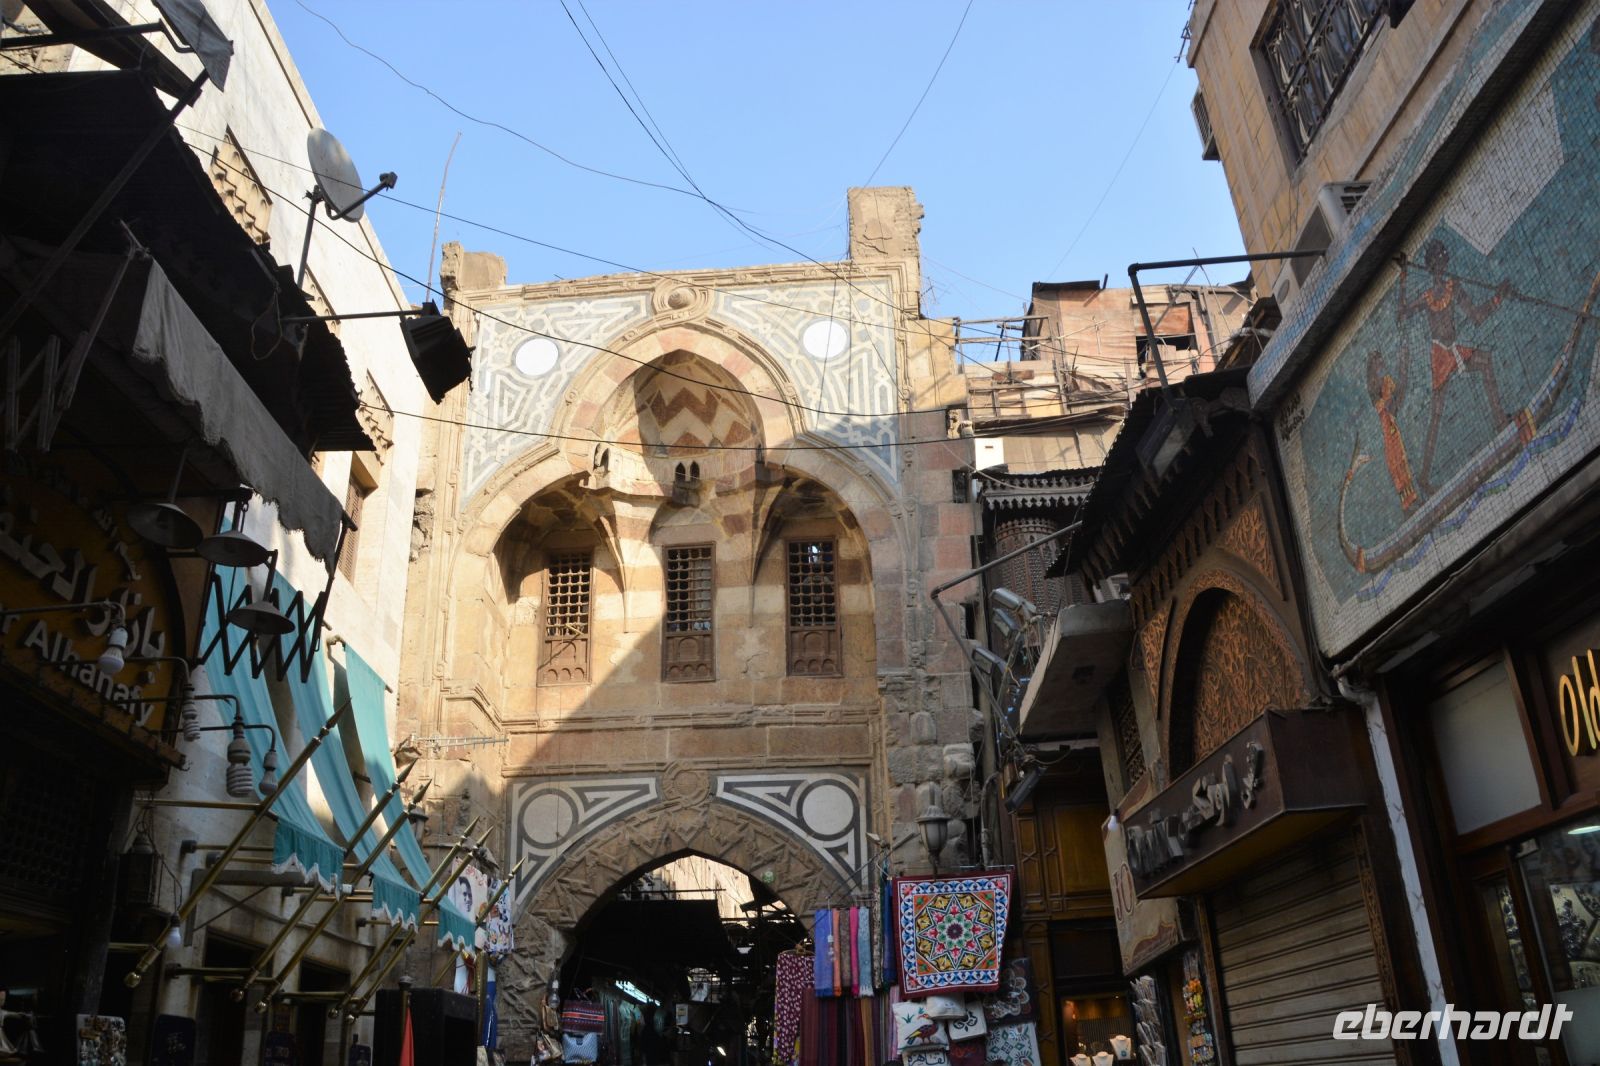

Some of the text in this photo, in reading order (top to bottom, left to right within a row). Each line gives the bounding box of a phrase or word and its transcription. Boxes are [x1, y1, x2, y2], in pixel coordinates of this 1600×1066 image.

[0, 490, 98, 606] الحنف
[23, 619, 155, 727] Alhanafy
[1559, 648, 1600, 757] Old
